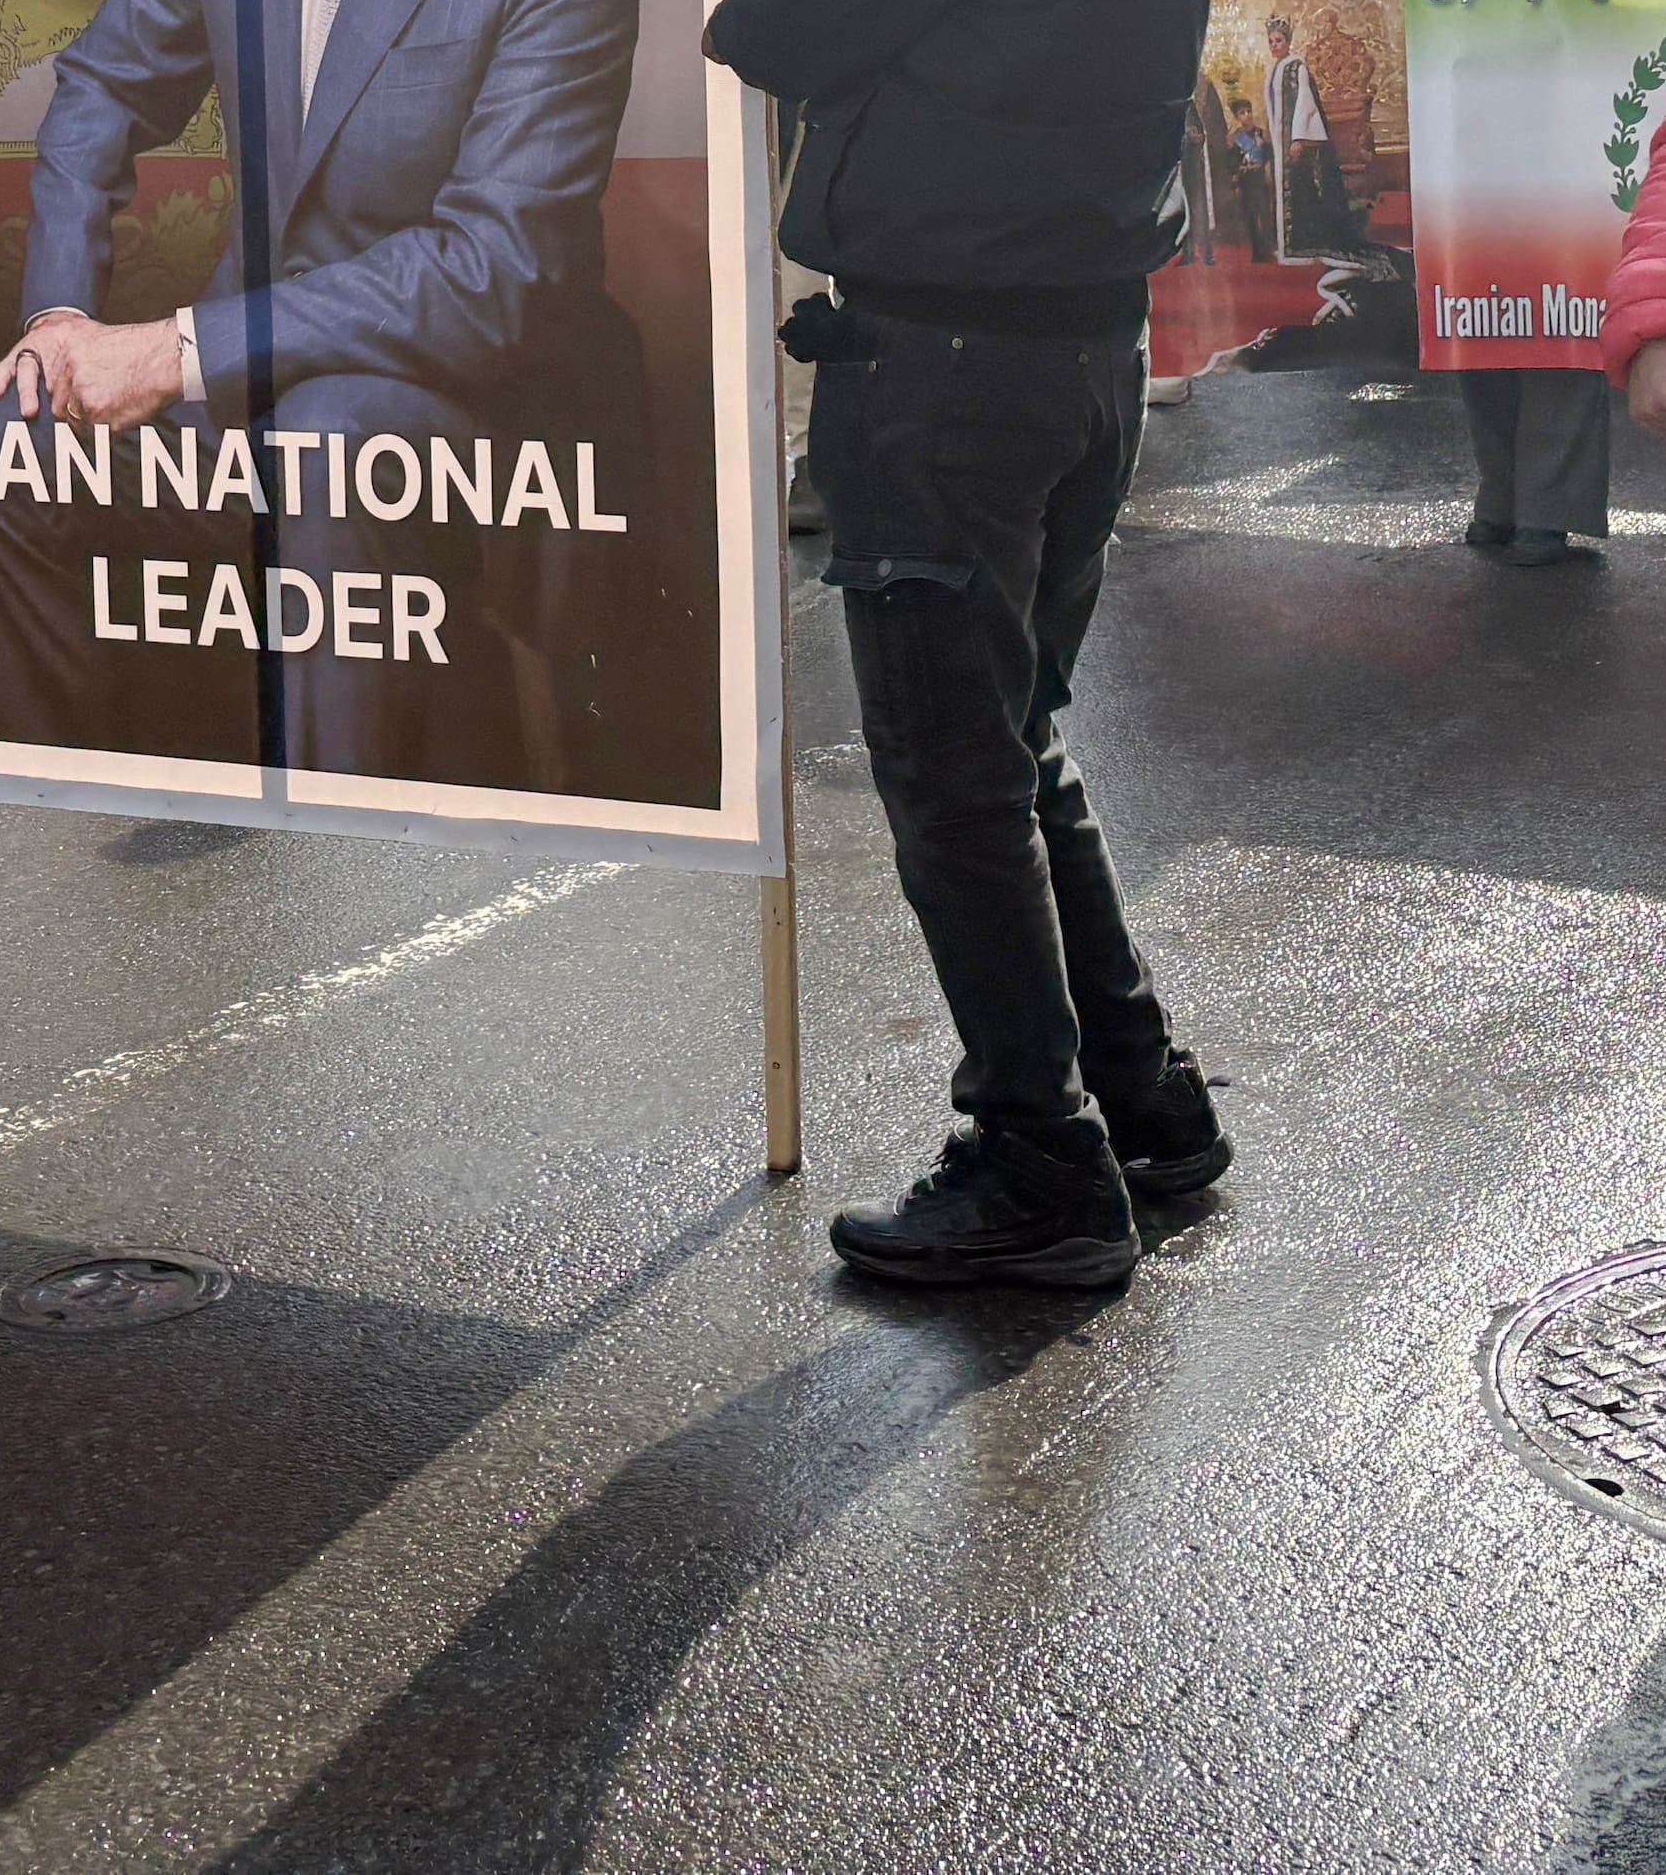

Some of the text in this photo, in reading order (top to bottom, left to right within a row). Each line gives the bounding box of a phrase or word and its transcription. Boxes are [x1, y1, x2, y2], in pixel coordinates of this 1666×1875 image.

[1434, 283, 1533, 338] Iranian
[139, 425, 627, 533] NATIONAL
[92, 556, 449, 665] LEADER
